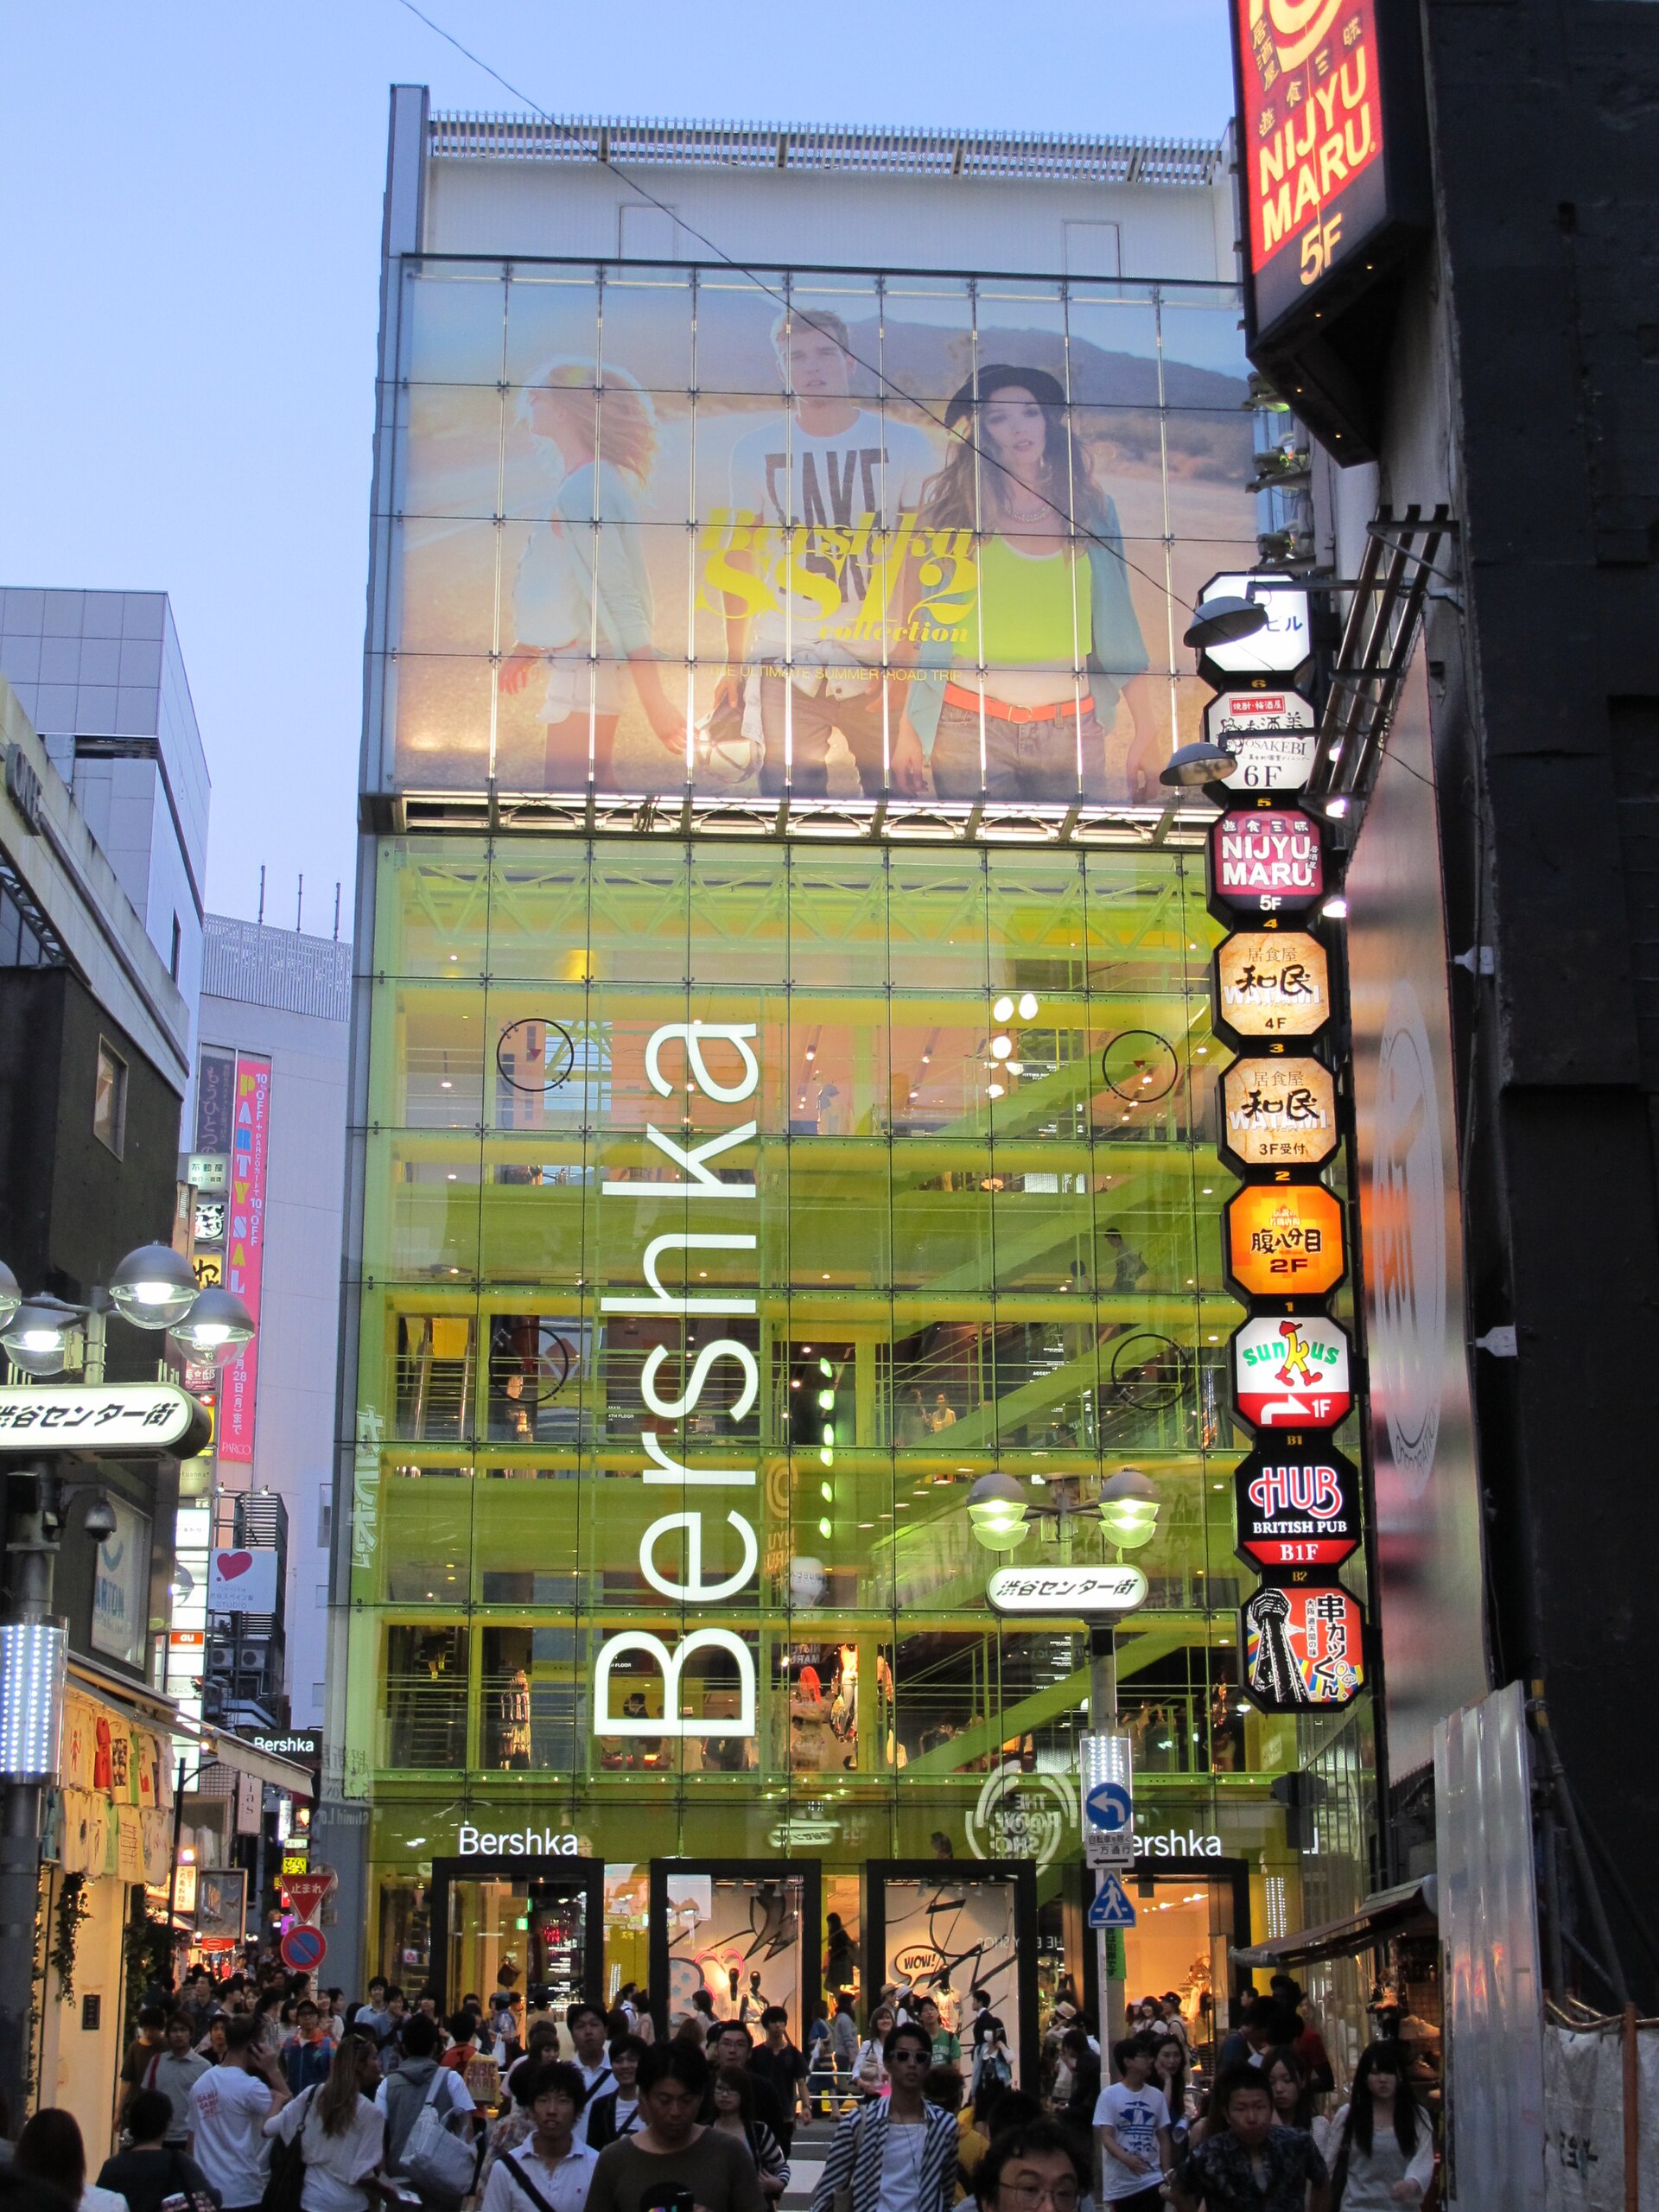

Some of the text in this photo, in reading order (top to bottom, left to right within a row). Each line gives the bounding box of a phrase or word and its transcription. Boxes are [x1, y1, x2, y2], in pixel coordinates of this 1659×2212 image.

[1259, 46, 1367, 197] NIJYU
[1262, 102, 1370, 251] MARU
[1300, 213, 1342, 286] 5F
[817, 620, 969, 642] collection
[814, 668, 879, 681] SUMMER
[931, 669, 962, 682] TRIP
[1252, 679, 1267, 689] 6
[1245, 739, 1306, 756] OSAKEBI
[1244, 765, 1282, 787] 6F
[1257, 798, 1272, 807] 5
[1222, 836, 1311, 860] NIJYU
[1223, 861, 1313, 887] MARU
[1259, 894, 1282, 911] 5F
[1263, 918, 1278, 929] 4
[1249, 947, 1299, 963] 居食屋
[1235, 964, 1313, 995] 和民
[1265, 1017, 1287, 1029] 4F
[1269, 1044, 1285, 1053] 3
[1254, 1071, 1304, 1087] 居食屋
[256, 1090, 265, 1121] OFF
[1241, 1089, 1319, 1121] 和民
[1259, 1143, 1306, 1155] 3F受付
[192, 1163, 224, 1173] 不動産
[1274, 1171, 1291, 1181] 2
[1250, 1228, 1322, 1254] 腹八分目
[1270, 1258, 1308, 1273] 2F
[1285, 1302, 1294, 1312] 1
[594, 1024, 759, 1736] Bershka
[1312, 1399, 1332, 1418] 1F
[1287, 1435, 1303, 1446] B1
[221, 1443, 251, 1455] PARCO
[1249, 1466, 1343, 1519] HUB
[1253, 1520, 1347, 1534] BRITISH PUB
[1280, 1543, 1319, 1561] B1F
[1292, 1571, 1308, 1582] B2
[996, 1578, 1139, 1597] 渋谷センター街
[180, 1634, 194, 1643] au
[254, 1736, 314, 1752] Bershka
[459, 1827, 579, 1856] Bershka
[1088, 1834, 1130, 1845] 自転車を除く
[1132, 1829, 1222, 1857] ershka
[1090, 1846, 1131, 1855] 一方通行
[291, 1884, 322, 1895] 止まれ
[903, 1953, 937, 1970] WOW!
